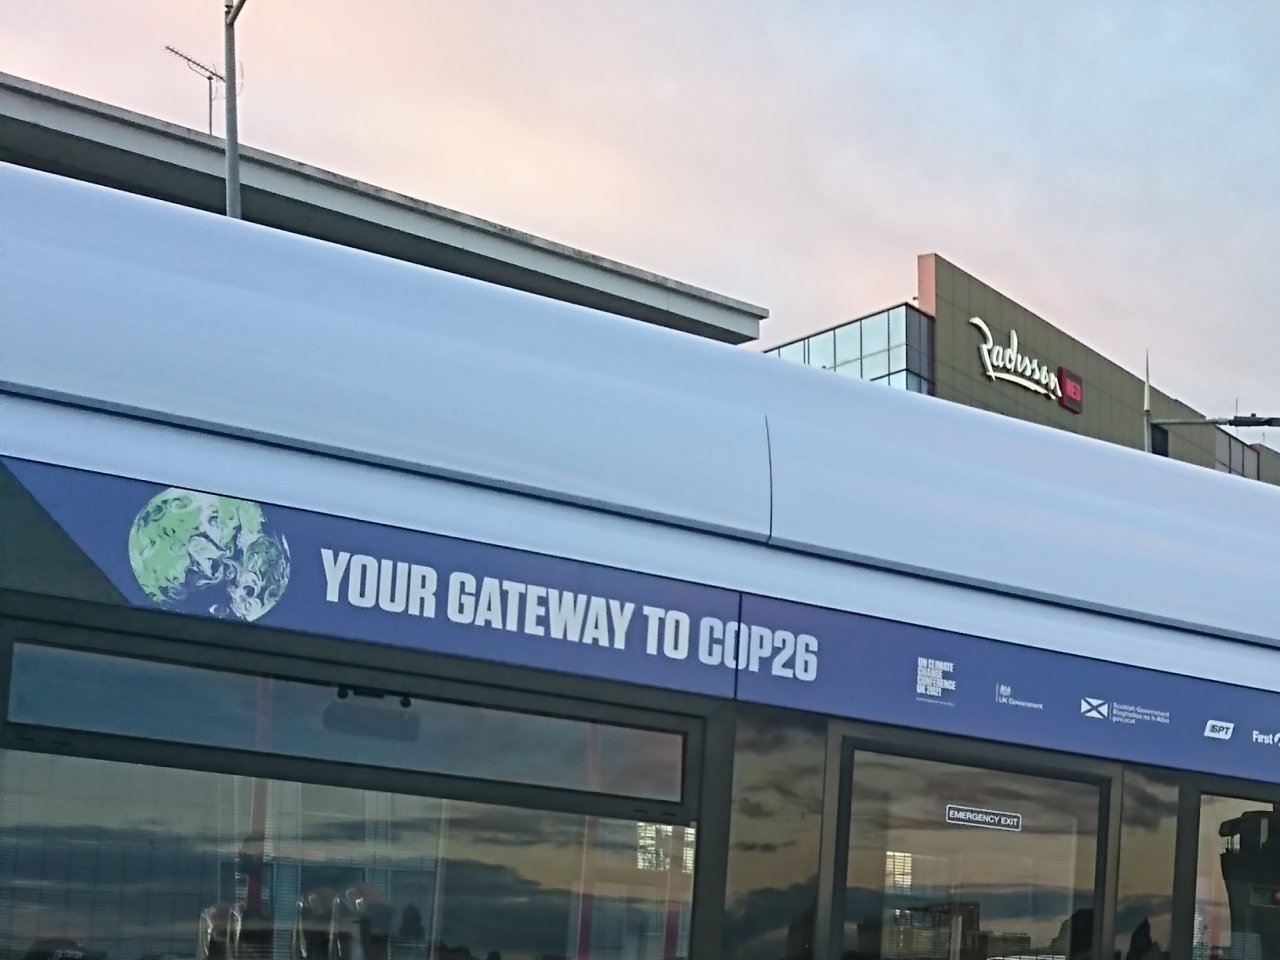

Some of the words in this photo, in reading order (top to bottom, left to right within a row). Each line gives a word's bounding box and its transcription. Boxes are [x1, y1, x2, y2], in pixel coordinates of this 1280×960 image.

[968, 316, 1062, 399] Radisson
[320, 547, 437, 618] YOUR
[447, 571, 635, 650] GATEWAY
[642, 605, 689, 660] TO
[698, 616, 818, 682] COP26
[1009, 698, 1043, 710] Government
[1210, 724, 1231, 736] SPT
[1252, 730, 1274, 745] First
[949, 809, 999, 824] EMERGENCY
[1001, 817, 1019, 827] EXIT
